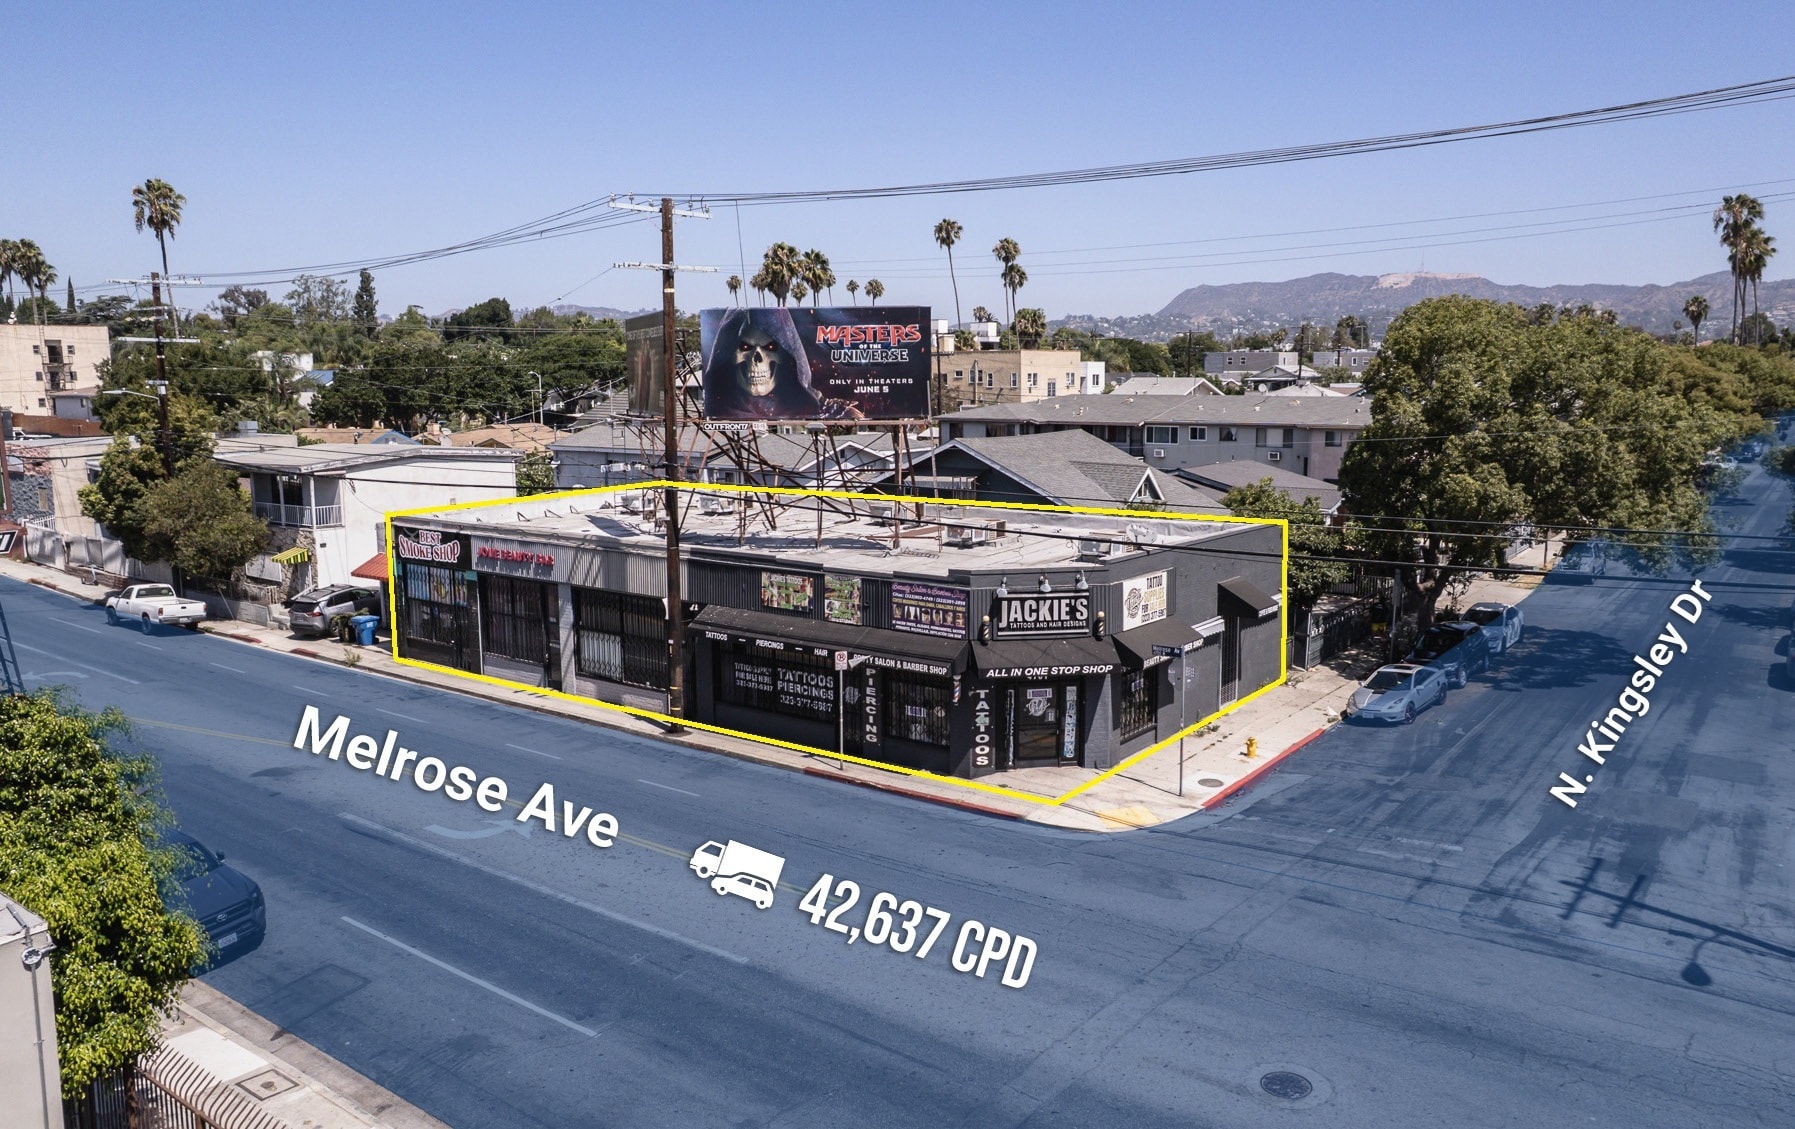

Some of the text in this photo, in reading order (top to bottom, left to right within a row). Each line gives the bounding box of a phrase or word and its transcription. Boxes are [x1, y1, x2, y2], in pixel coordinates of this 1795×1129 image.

[816, 324, 922, 347] MASTERS
[831, 349, 909, 363] UNIVERSE
[418, 529, 442, 546] BEST
[398, 535, 461, 564] SMOKE SHOP
[999, 599, 1088, 628] JACKIE'S
[705, 631, 728, 641] TATTOOS
[755, 639, 784, 650] PIERCINGS
[814, 647, 828, 657] HAIR
[874, 656, 895, 668] SALON
[896, 661, 902, 669] &
[902, 661, 928, 673] BARBER
[929, 665, 947, 676] SHOP
[986, 665, 1113, 678] ALL IN ONE STOP SHOP
[778, 667, 834, 688] TATTOOS
[778, 681, 834, 701] PIERCINGS
[866, 668, 878, 743] PIERCING
